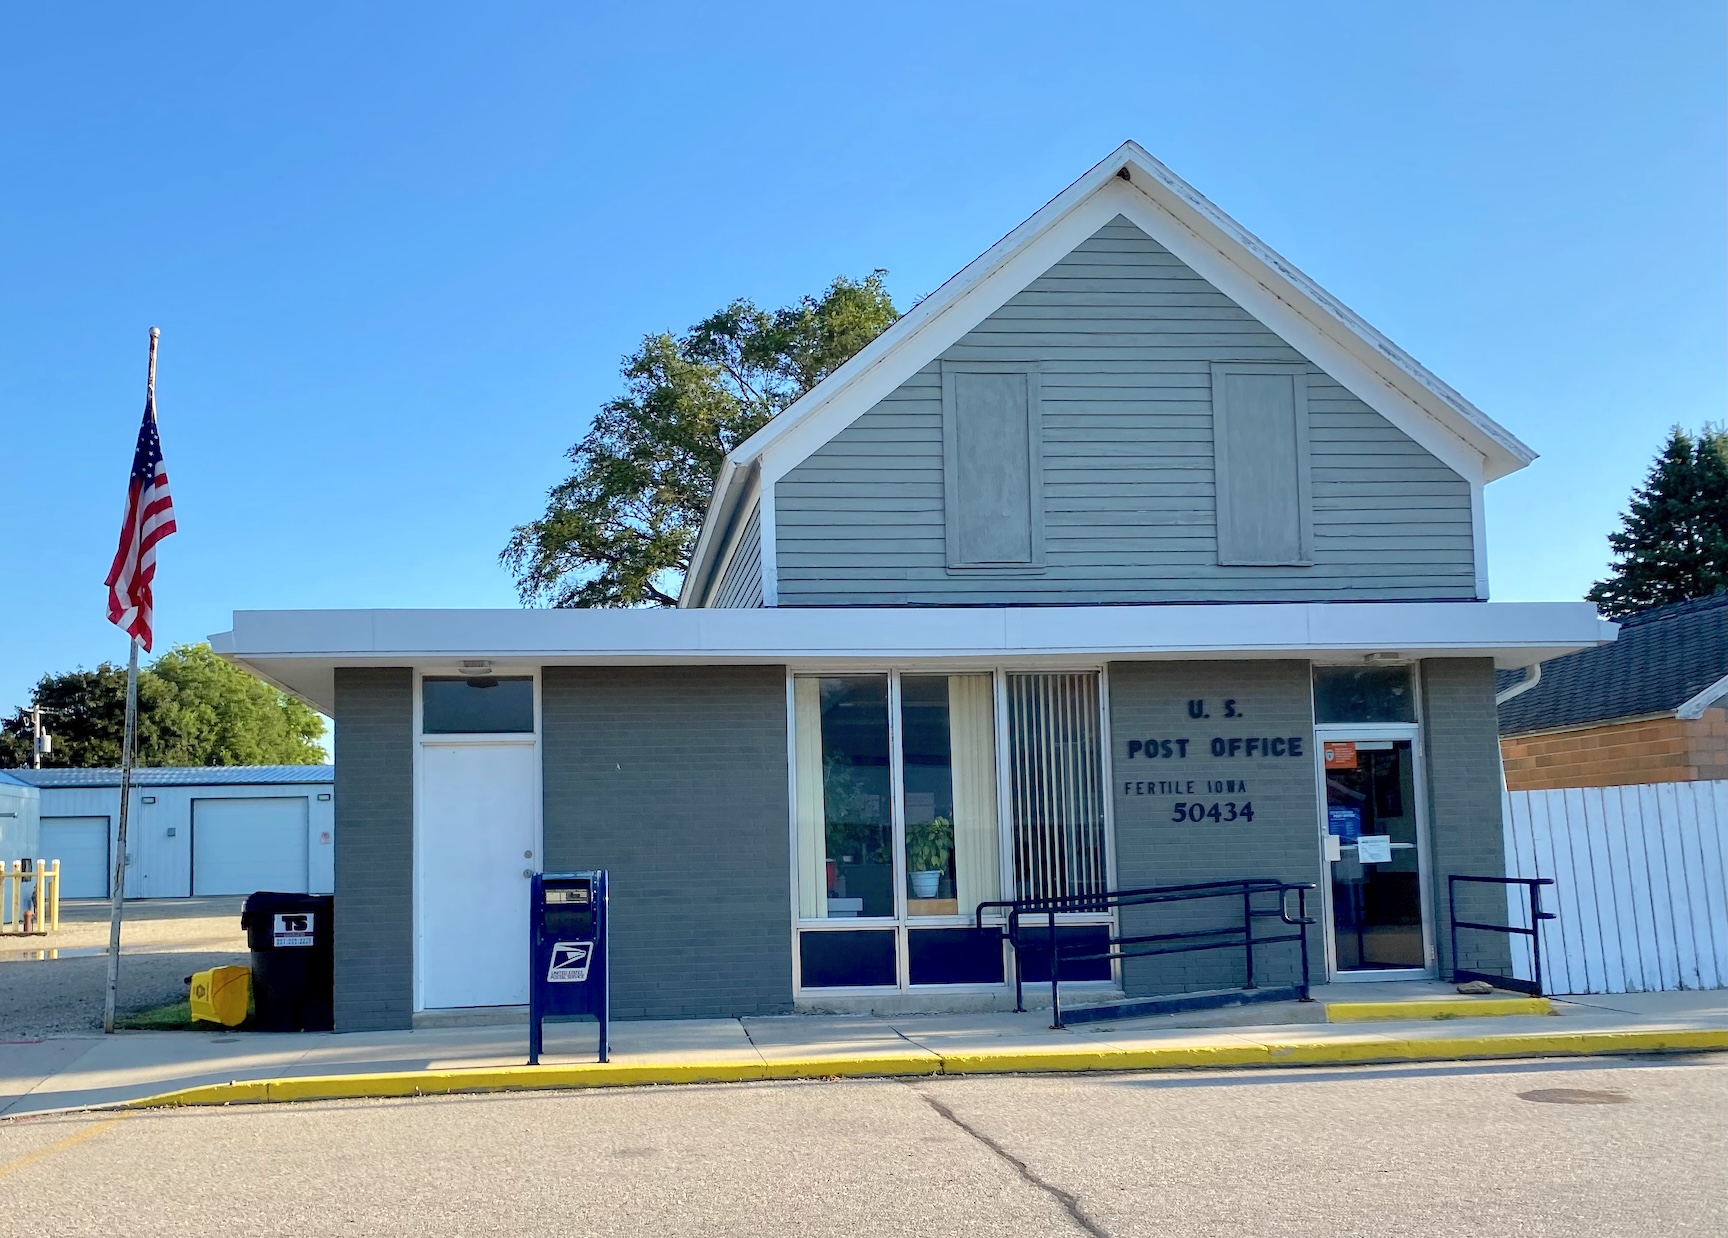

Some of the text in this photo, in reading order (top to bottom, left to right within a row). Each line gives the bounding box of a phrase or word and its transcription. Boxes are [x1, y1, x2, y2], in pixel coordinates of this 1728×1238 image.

[1188, 699, 1243, 719] U. S.
[1128, 737, 1303, 759] POST OFFICE
[1124, 780, 1246, 795] FERTILE IOWA
[1171, 801, 1255, 823] 50434
[281, 915, 308, 931] TS
